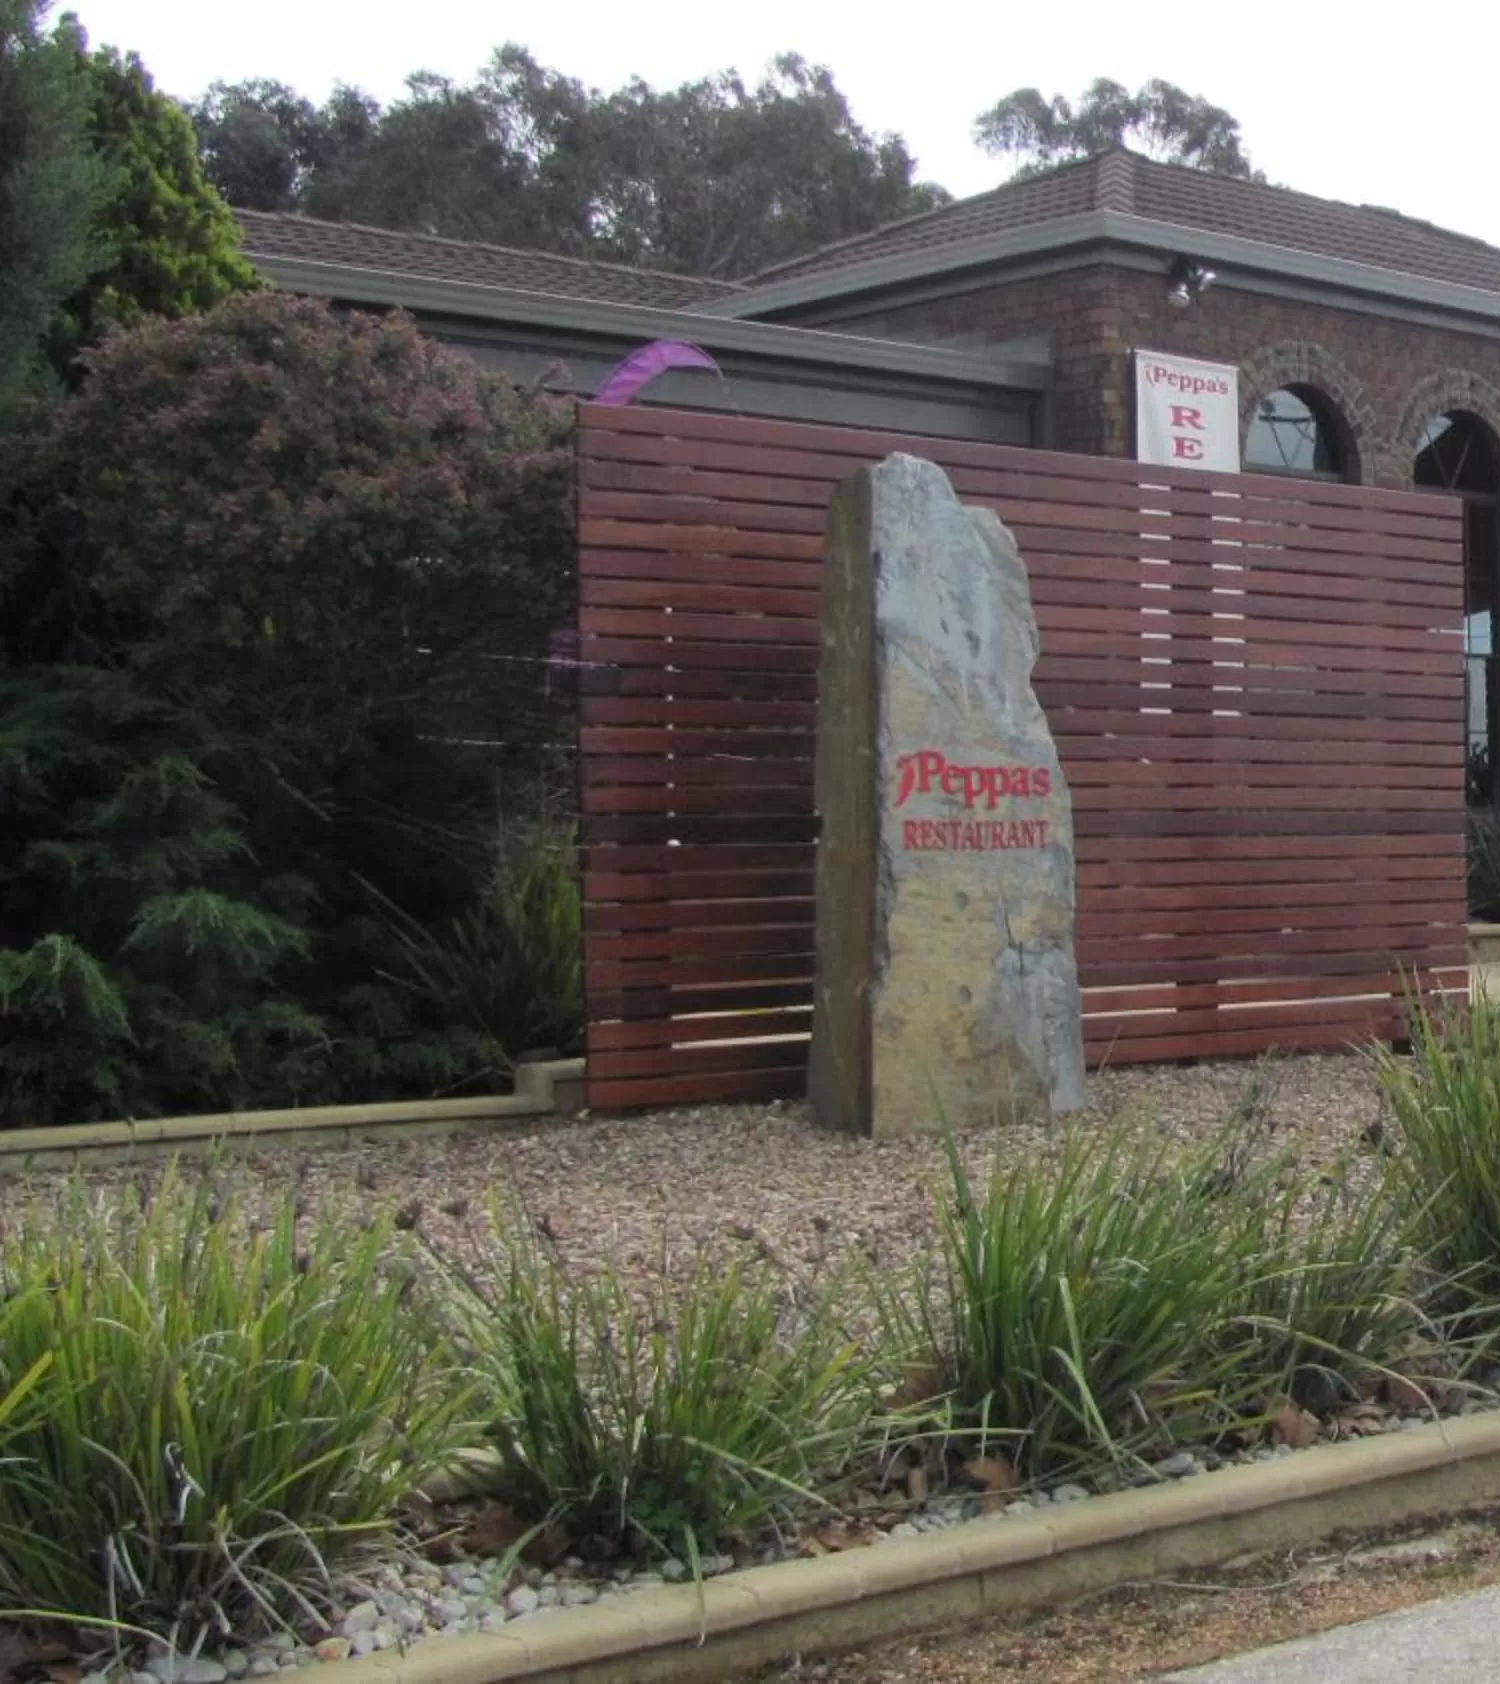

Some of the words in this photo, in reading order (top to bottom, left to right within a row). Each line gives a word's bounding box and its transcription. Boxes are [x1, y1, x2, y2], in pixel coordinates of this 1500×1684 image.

[1153, 366, 1229, 395] Peppa's
[917, 749, 1052, 810] Peppas
[903, 819, 1049, 850] RESTAURANT
